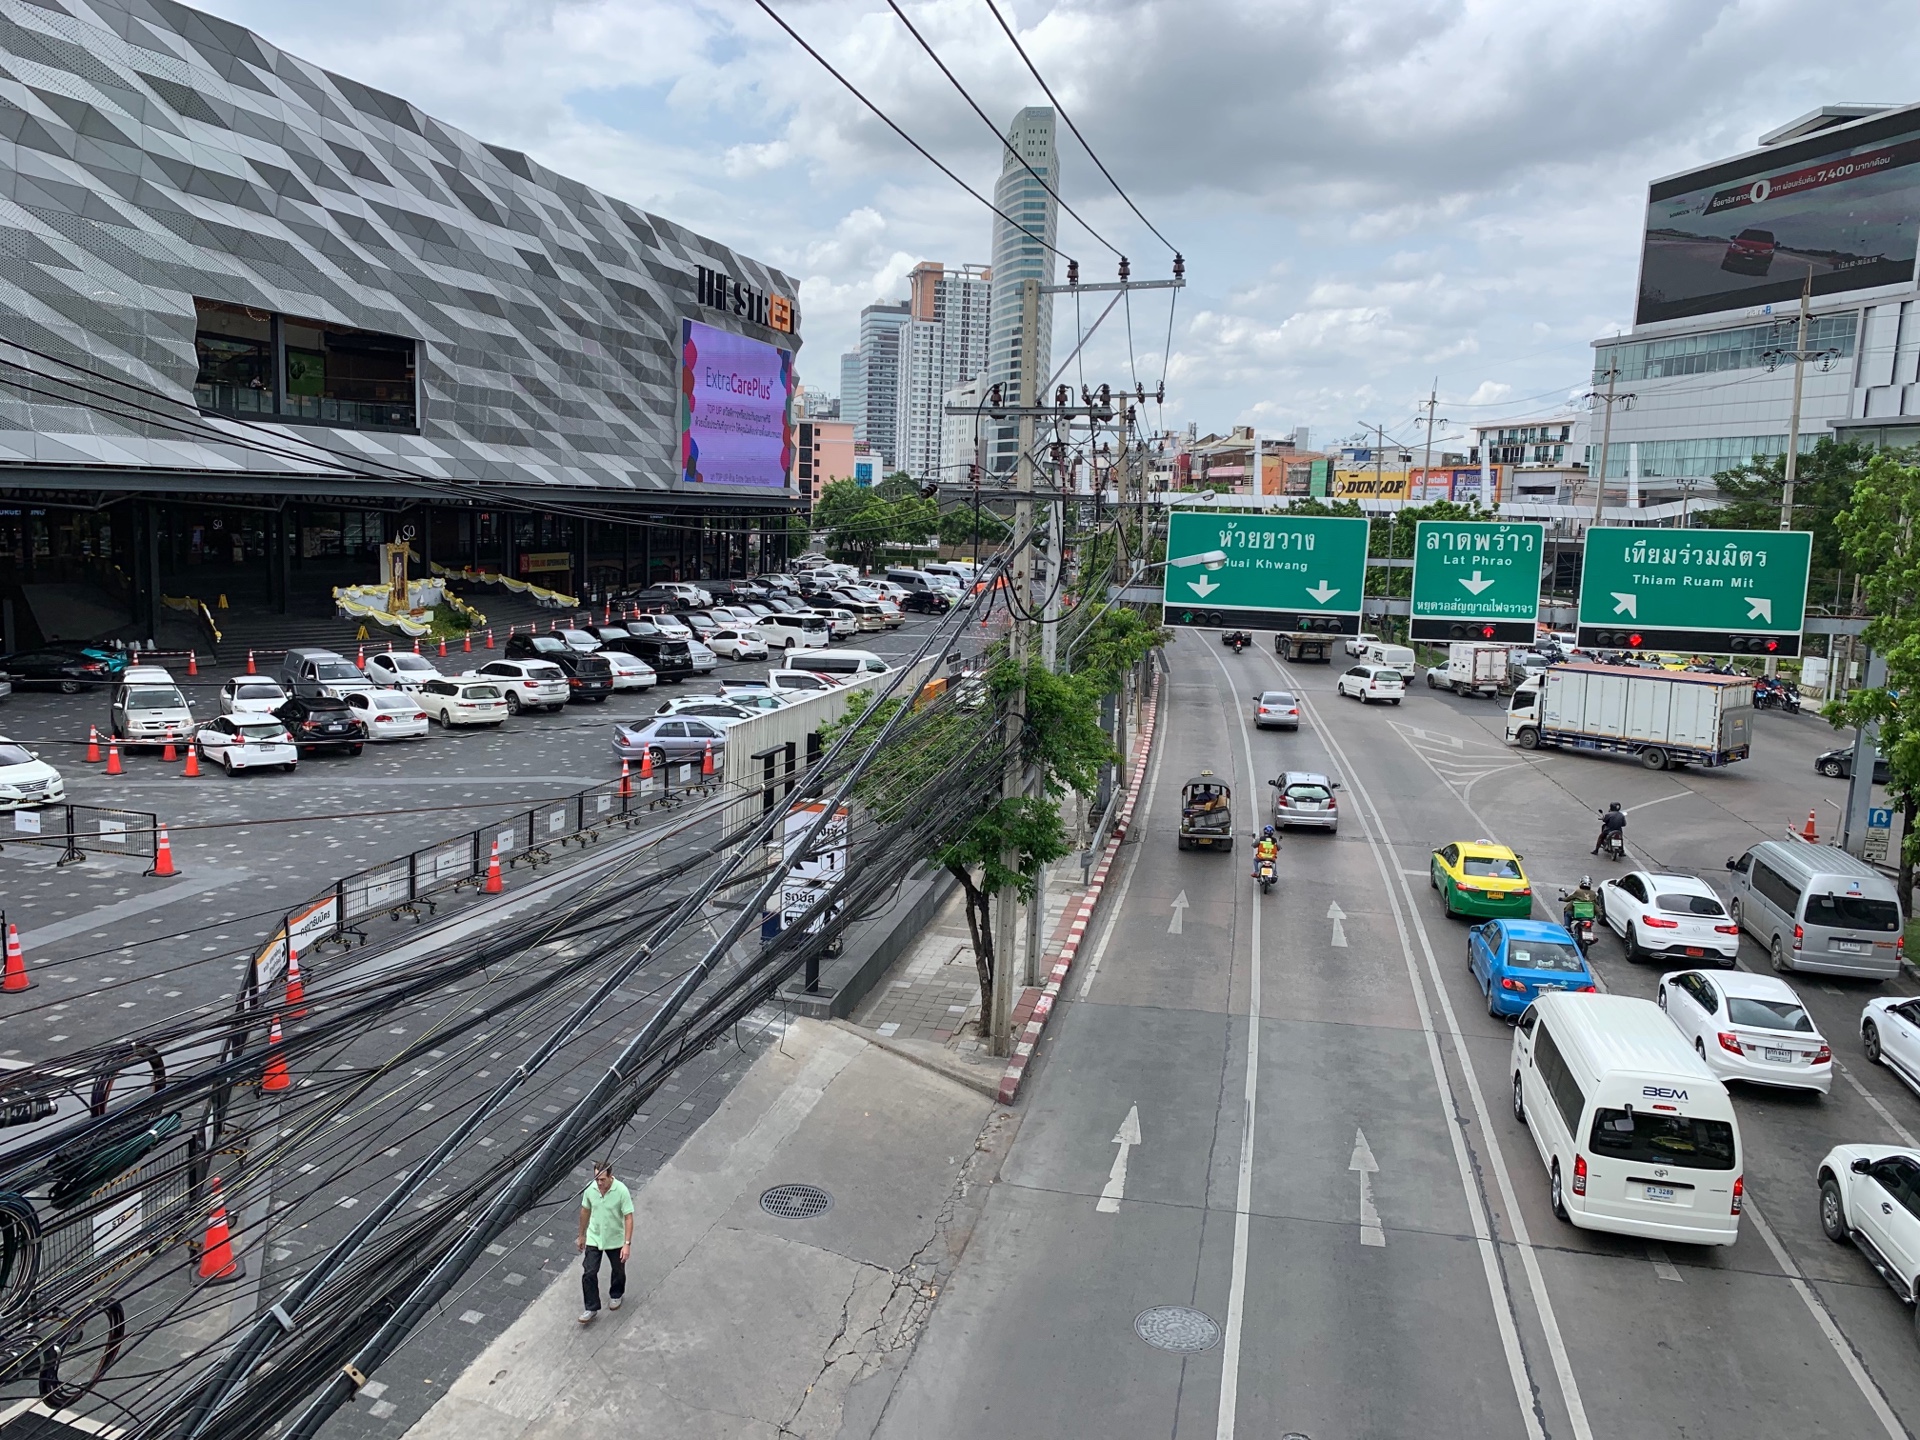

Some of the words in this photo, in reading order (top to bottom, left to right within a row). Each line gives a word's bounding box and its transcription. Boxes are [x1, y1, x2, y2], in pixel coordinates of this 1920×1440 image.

[1750, 180, 1770, 204] 0
[1817, 164, 1854, 182] 7,400
[734, 281, 798, 335] STREET
[1218, 522, 1316, 551] ห้วยขวาง
[1426, 525, 1534, 552] ลาดพร้าว
[1444, 555, 1466, 566] Lat
[1472, 556, 1514, 566] Phrao
[1624, 540, 1768, 568] เทียมร่วมมิตร
[1256, 558, 1309, 573] Khwang
[1632, 574, 1676, 586] Thiam
[1683, 576, 1724, 588] Ruam
[1730, 577, 1754, 588] Mit
[1416, 598, 1534, 614] หยุดรอสัญญาณไฟจราจร
[826, 852, 834, 870] 1
[785, 891, 815, 904] รถบัส
[1642, 1086, 1689, 1100] BEM
